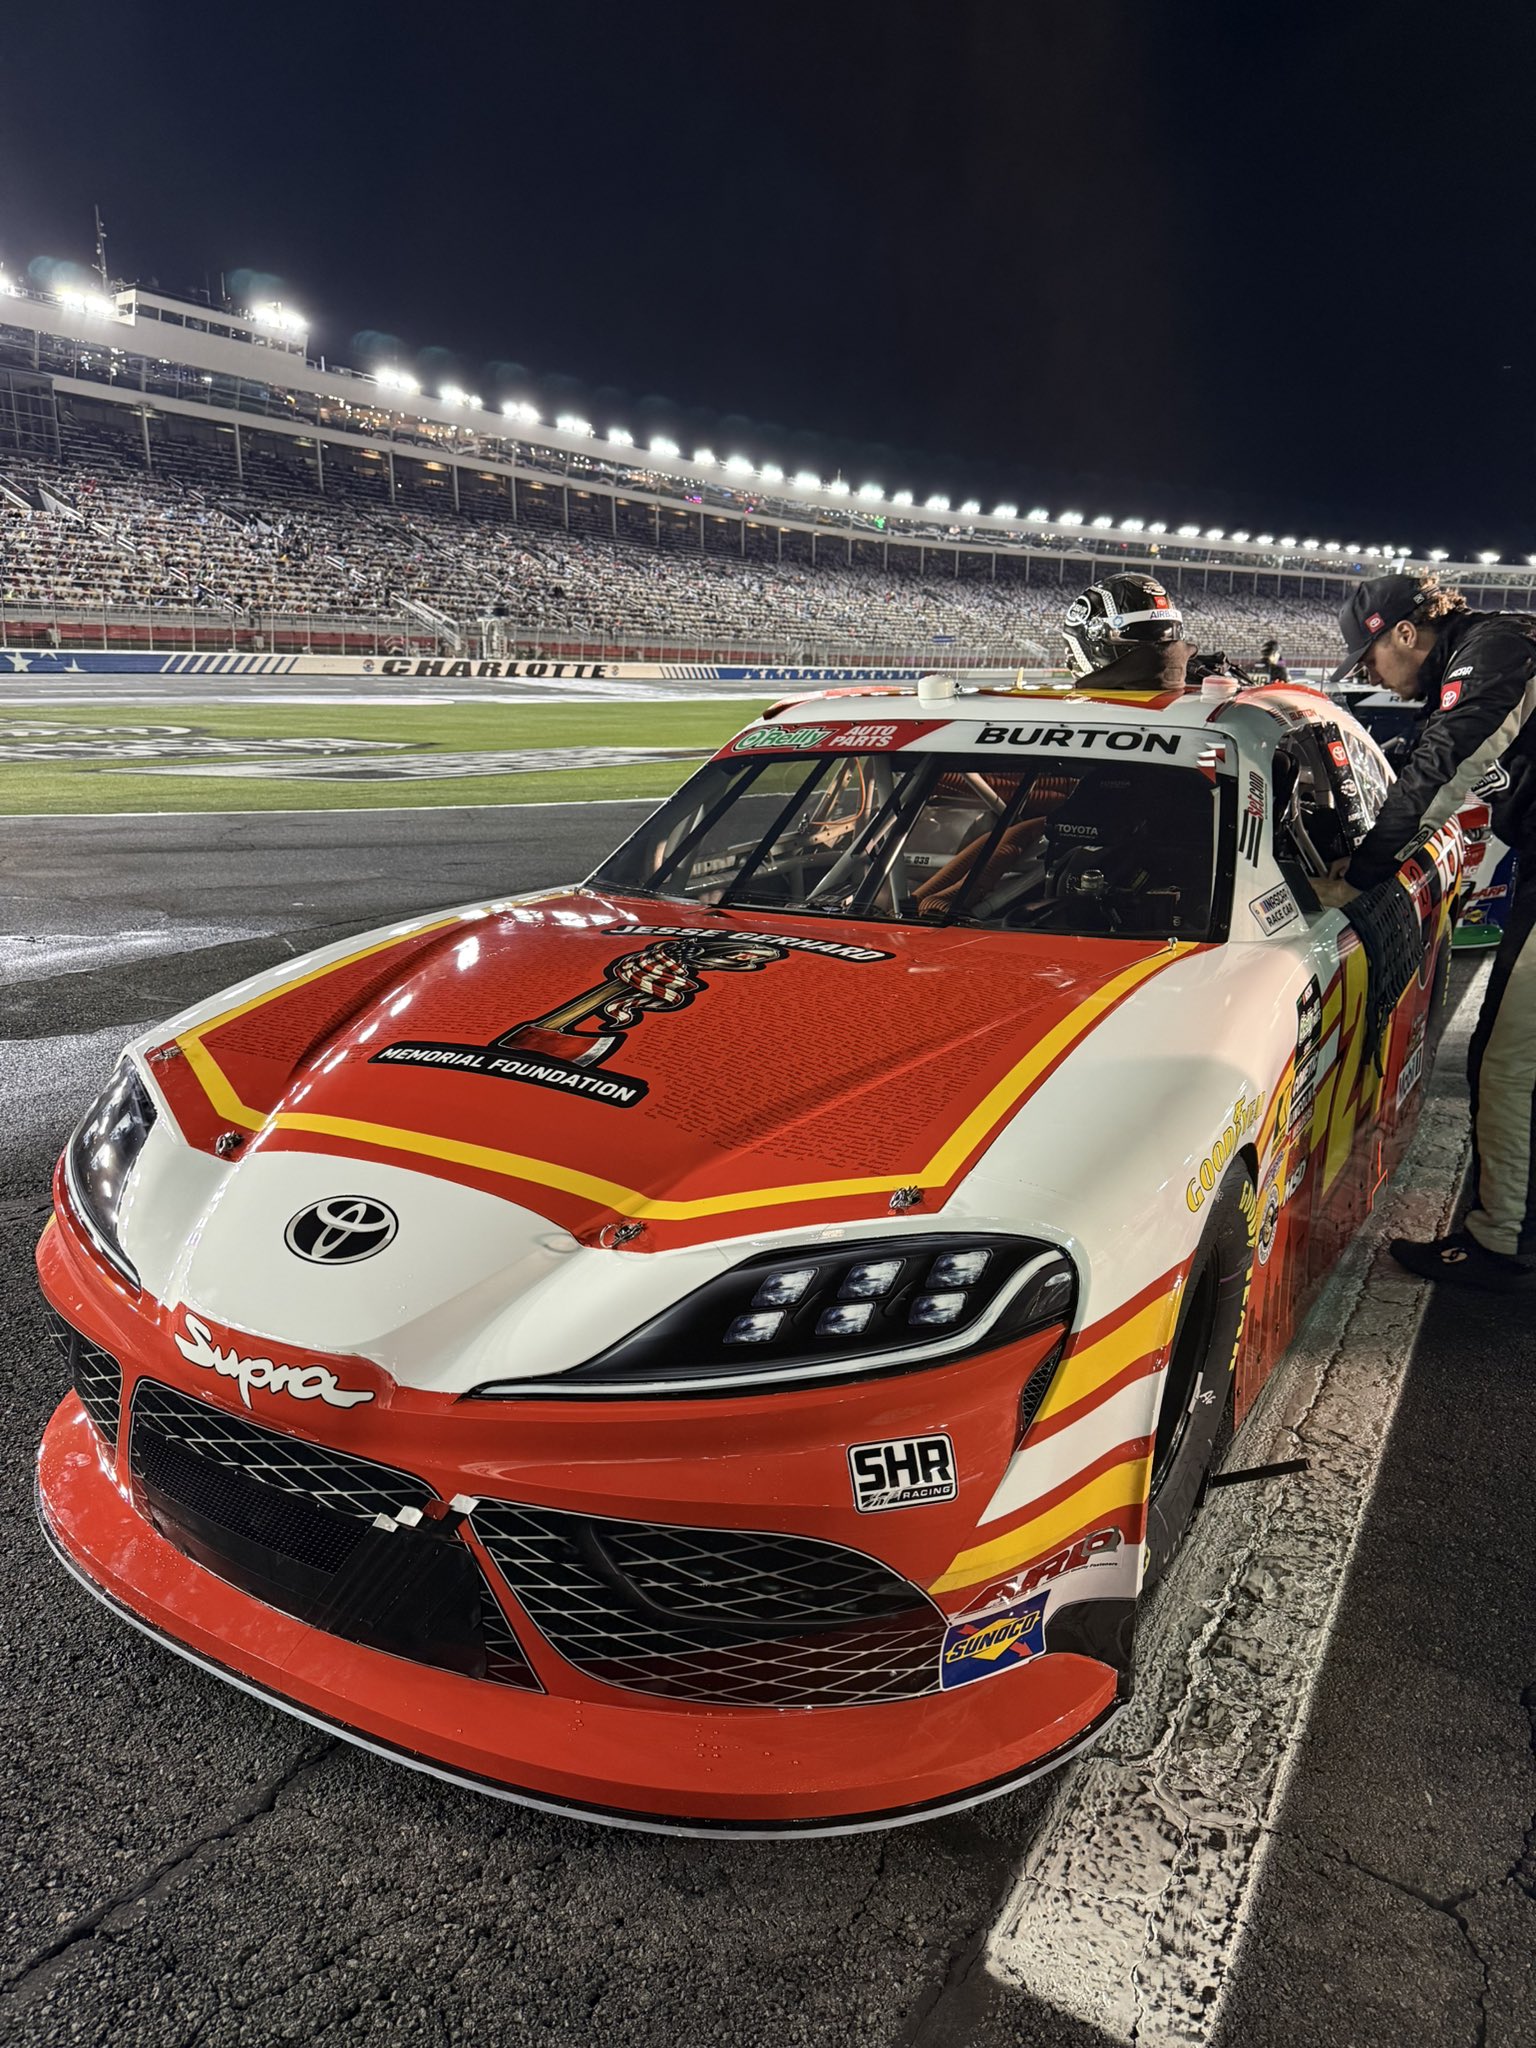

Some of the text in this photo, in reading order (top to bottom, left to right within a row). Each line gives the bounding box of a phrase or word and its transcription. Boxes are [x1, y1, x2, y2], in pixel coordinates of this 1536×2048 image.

[382, 658, 608, 679] CHARLOTTE
[733, 725, 837, 750] O'Reilly
[828, 735, 893, 747] PARTS
[845, 725, 898, 736] AUTO
[975, 727, 1181, 754] BURTON
[1057, 823, 1098, 836] TOYOTA
[1266, 902, 1294, 927] RACE CAR
[610, 925, 887, 960] JESSE GERHARD
[378, 1048, 637, 1102] MEMORIAL FOUNDATION
[174, 1312, 375, 1410] Supra
[854, 1439, 952, 1493] SHR
[903, 1486, 951, 1499] RACING
[949, 1612, 1039, 1660] SUNOCO
